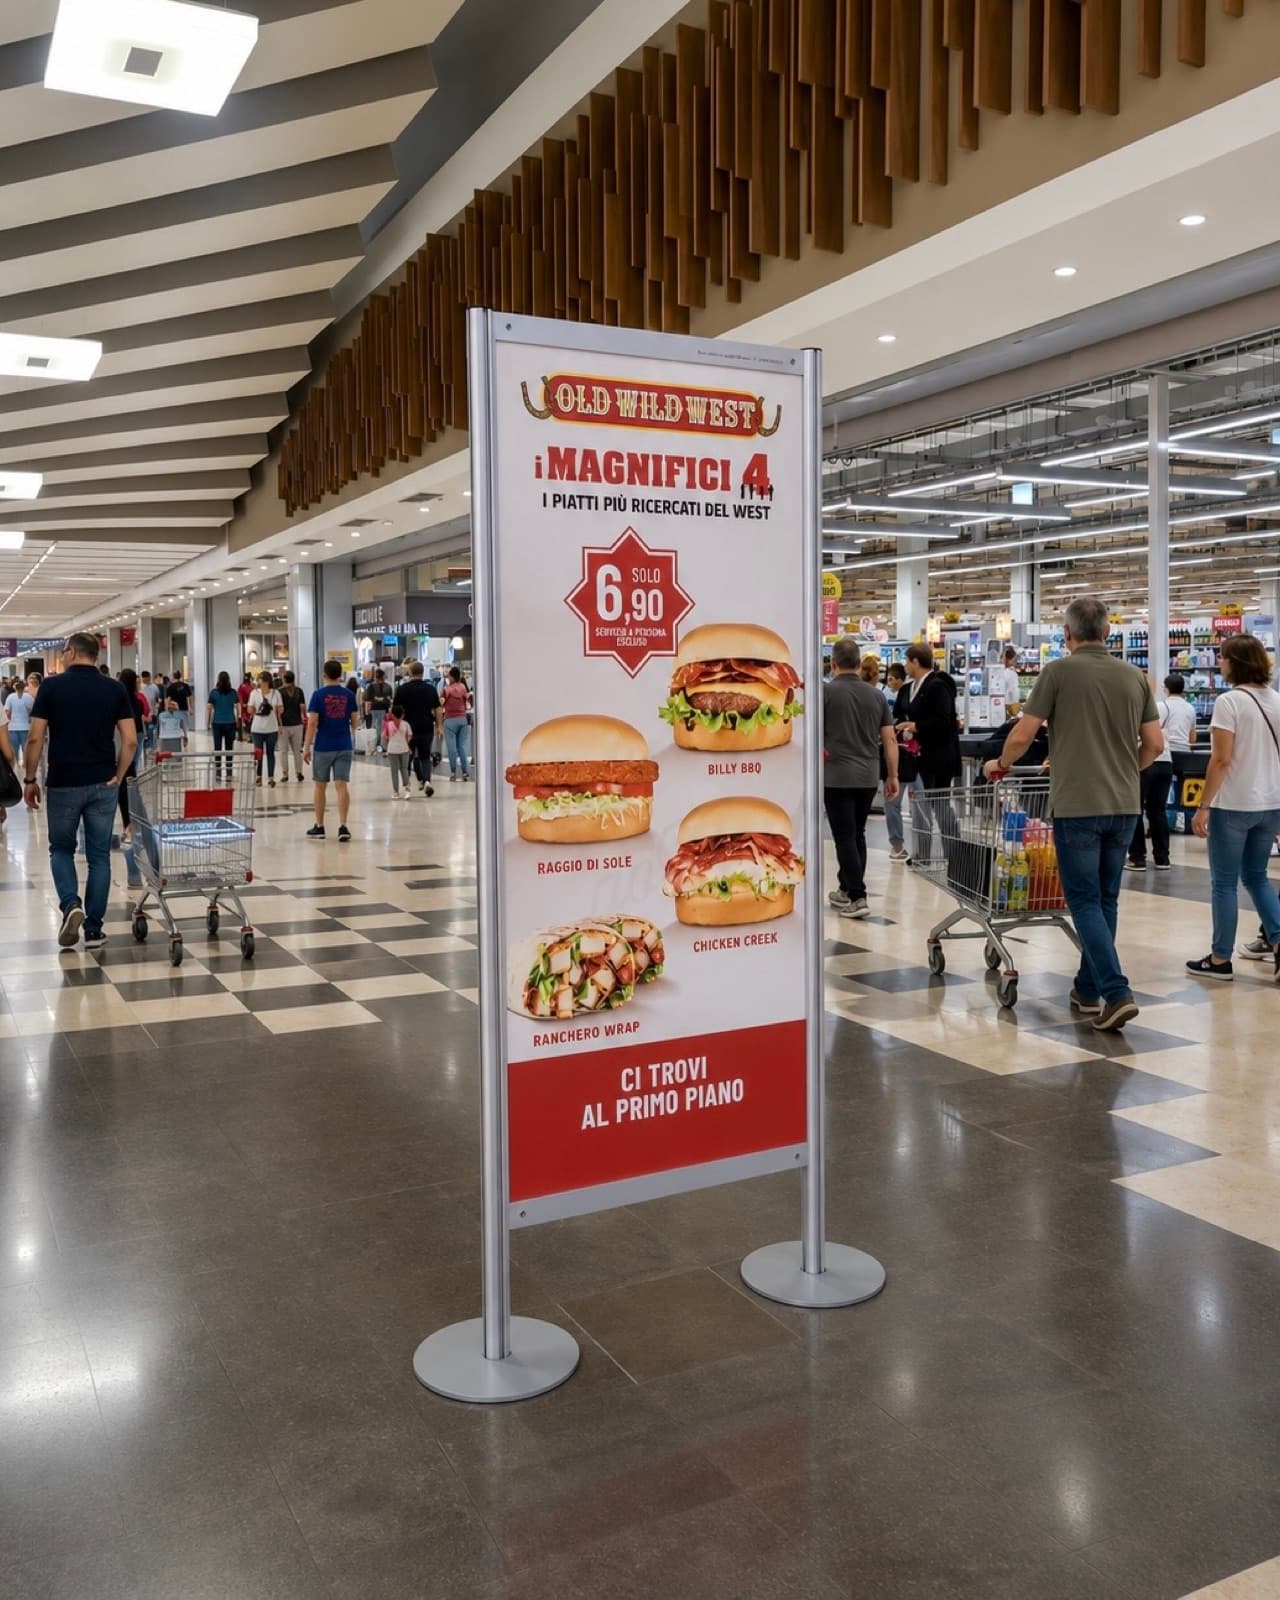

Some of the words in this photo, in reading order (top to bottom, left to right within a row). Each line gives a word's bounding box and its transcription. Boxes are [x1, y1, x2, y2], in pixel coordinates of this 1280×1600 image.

[555, 383, 612, 415] OLD
[615, 388, 684, 422] WILD
[685, 395, 756, 429] WEST
[547, 445, 731, 491] MAGNIFICI
[741, 453, 771, 497] 4
[542, 493, 547, 508] I
[553, 493, 599, 511] PIATTI
[604, 494, 627, 513] PIÙ
[632, 498, 701, 516] RICERCATI
[705, 503, 730, 518] DEL
[733, 504, 771, 520] WEST
[632, 567, 660, 583] SOLO
[596, 564, 664, 625] 6,90
[708, 763, 737, 776] BILLY
[741, 762, 762, 774] BBQ
[537, 860, 582, 875] RAGGIO
[586, 858, 599, 871] DI
[603, 856, 632, 870] SOLE
[693, 936, 741, 953] CHICKEN
[744, 932, 778, 945] CREEK
[533, 1026, 600, 1047] RANCHERO
[604, 1021, 641, 1037] WRAP
[621, 1066, 641, 1092] CI
[648, 1056, 707, 1088] TROVI
[581, 1103, 610, 1130] AL
[616, 1090, 679, 1123] PRIMO
[685, 1078, 744, 1111] PIANO
